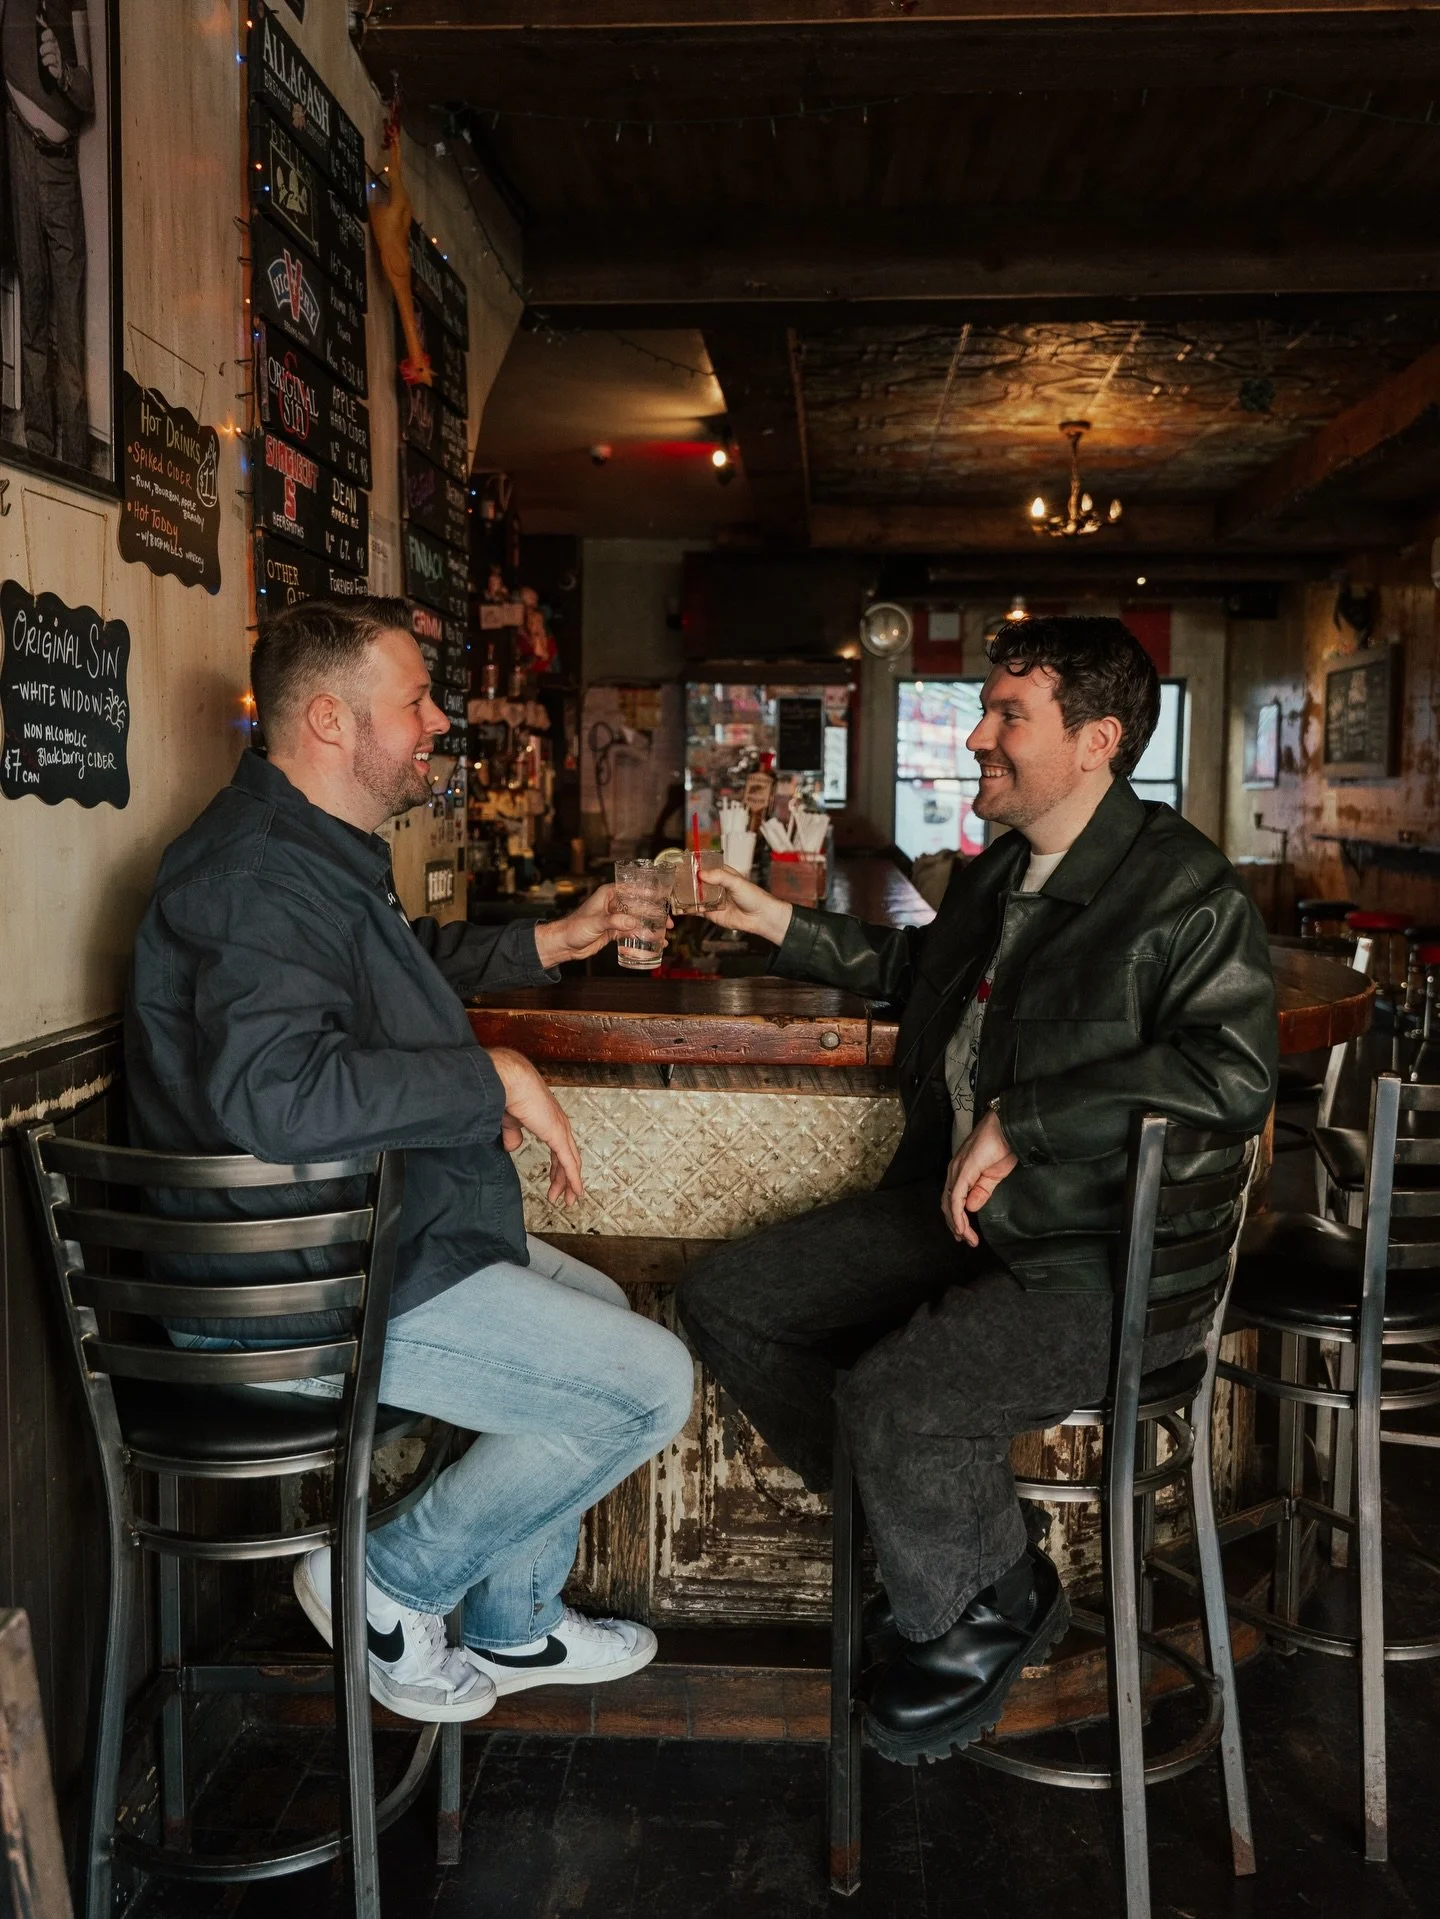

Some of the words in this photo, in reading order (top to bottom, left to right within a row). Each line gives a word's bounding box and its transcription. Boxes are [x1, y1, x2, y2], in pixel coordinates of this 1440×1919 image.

[262, 16, 331, 137] ALLAGASH
[273, 273, 317, 325] VICTORY
[268, 356, 320, 418] ORIGINAL
[332, 384, 357, 423] APPLE
[348, 422, 368, 450] CIDER
[166, 460, 193, 491] CIDER
[331, 477, 357, 514] DEAN
[272, 511, 305, 540] BEERSMITHS
[266, 559, 300, 586] OTHER
[328, 568, 354, 596] FOREVER
[86, 622, 120, 680] SIN
[60, 687, 103, 717] WIDOW
[23, 722, 43, 740] NON
[45, 725, 88, 749] ALCOHOLIC
[4, 747, 22, 783] $7
[22, 769, 40, 784] CAN
[87, 751, 118, 771] CIDER
